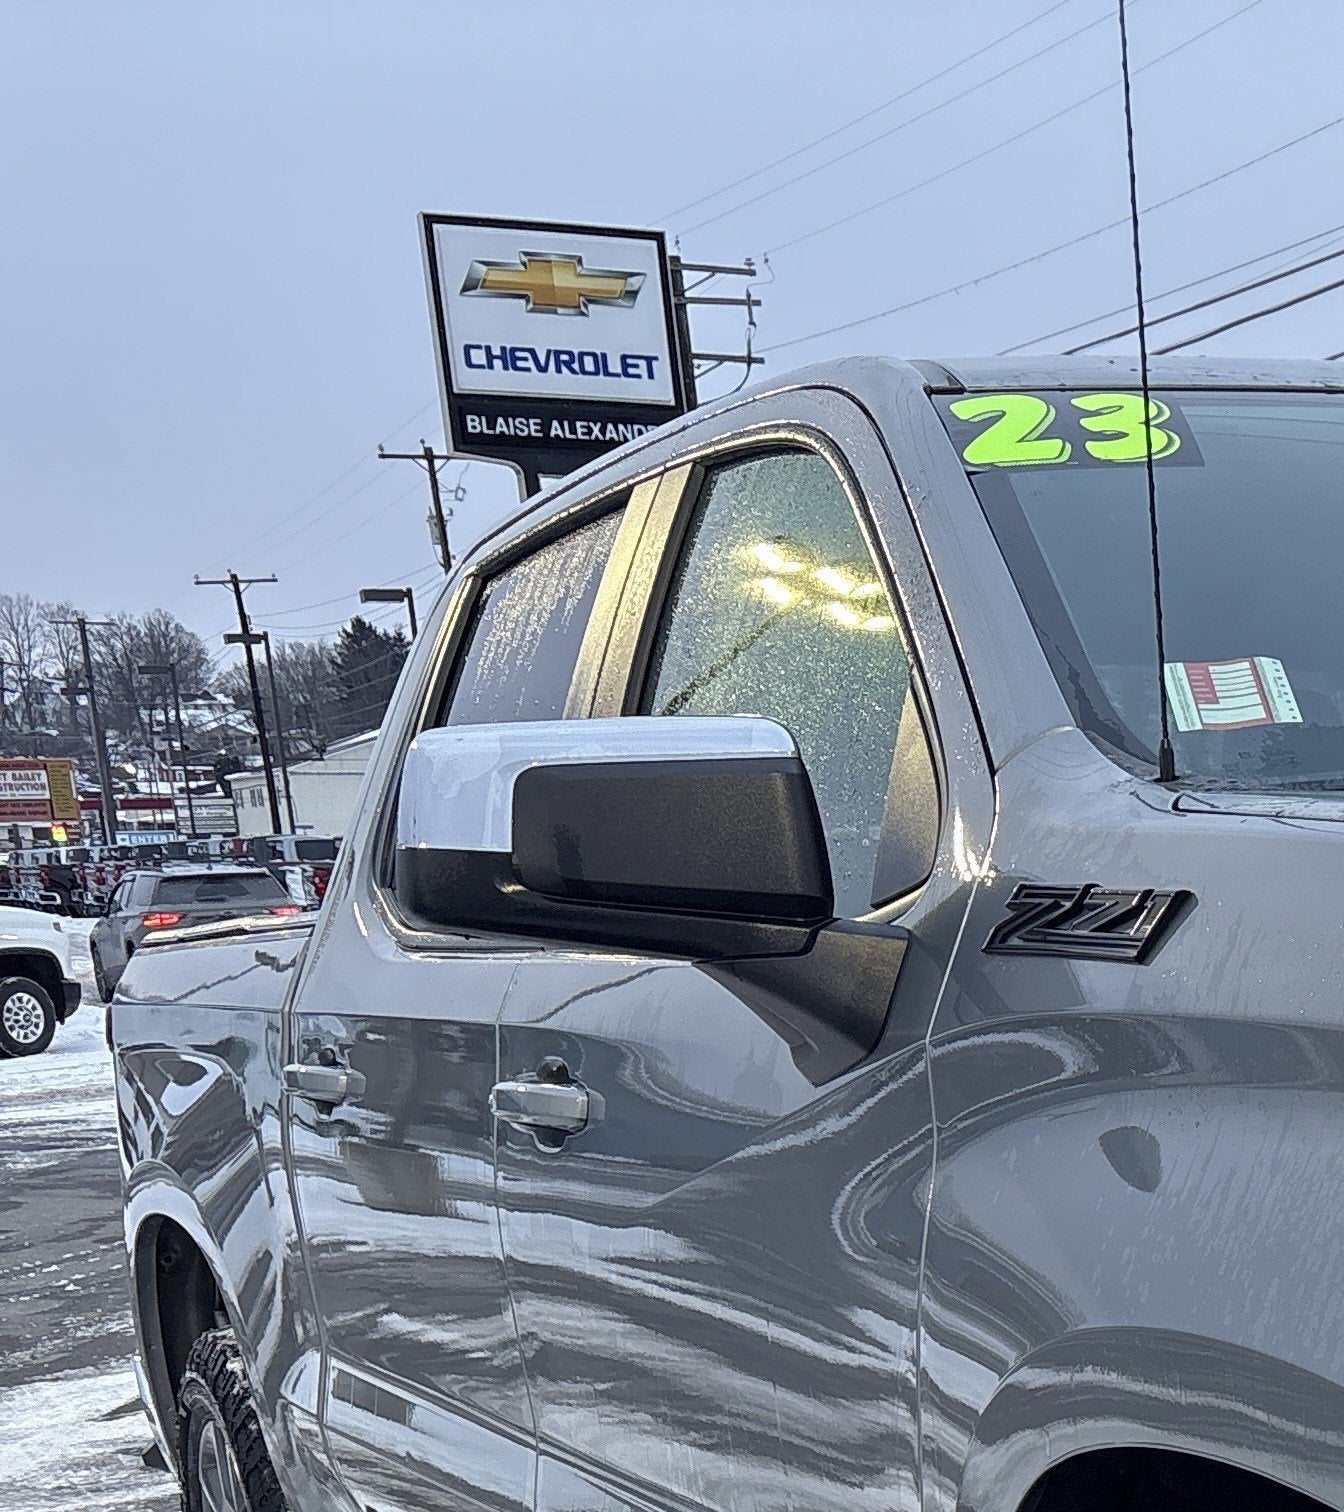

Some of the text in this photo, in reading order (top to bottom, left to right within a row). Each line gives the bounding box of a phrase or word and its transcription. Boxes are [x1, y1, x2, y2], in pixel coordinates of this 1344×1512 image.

[462, 343, 660, 380] CHEVROLET
[465, 414, 544, 437] BLAISE
[949, 392, 1182, 464] 23
